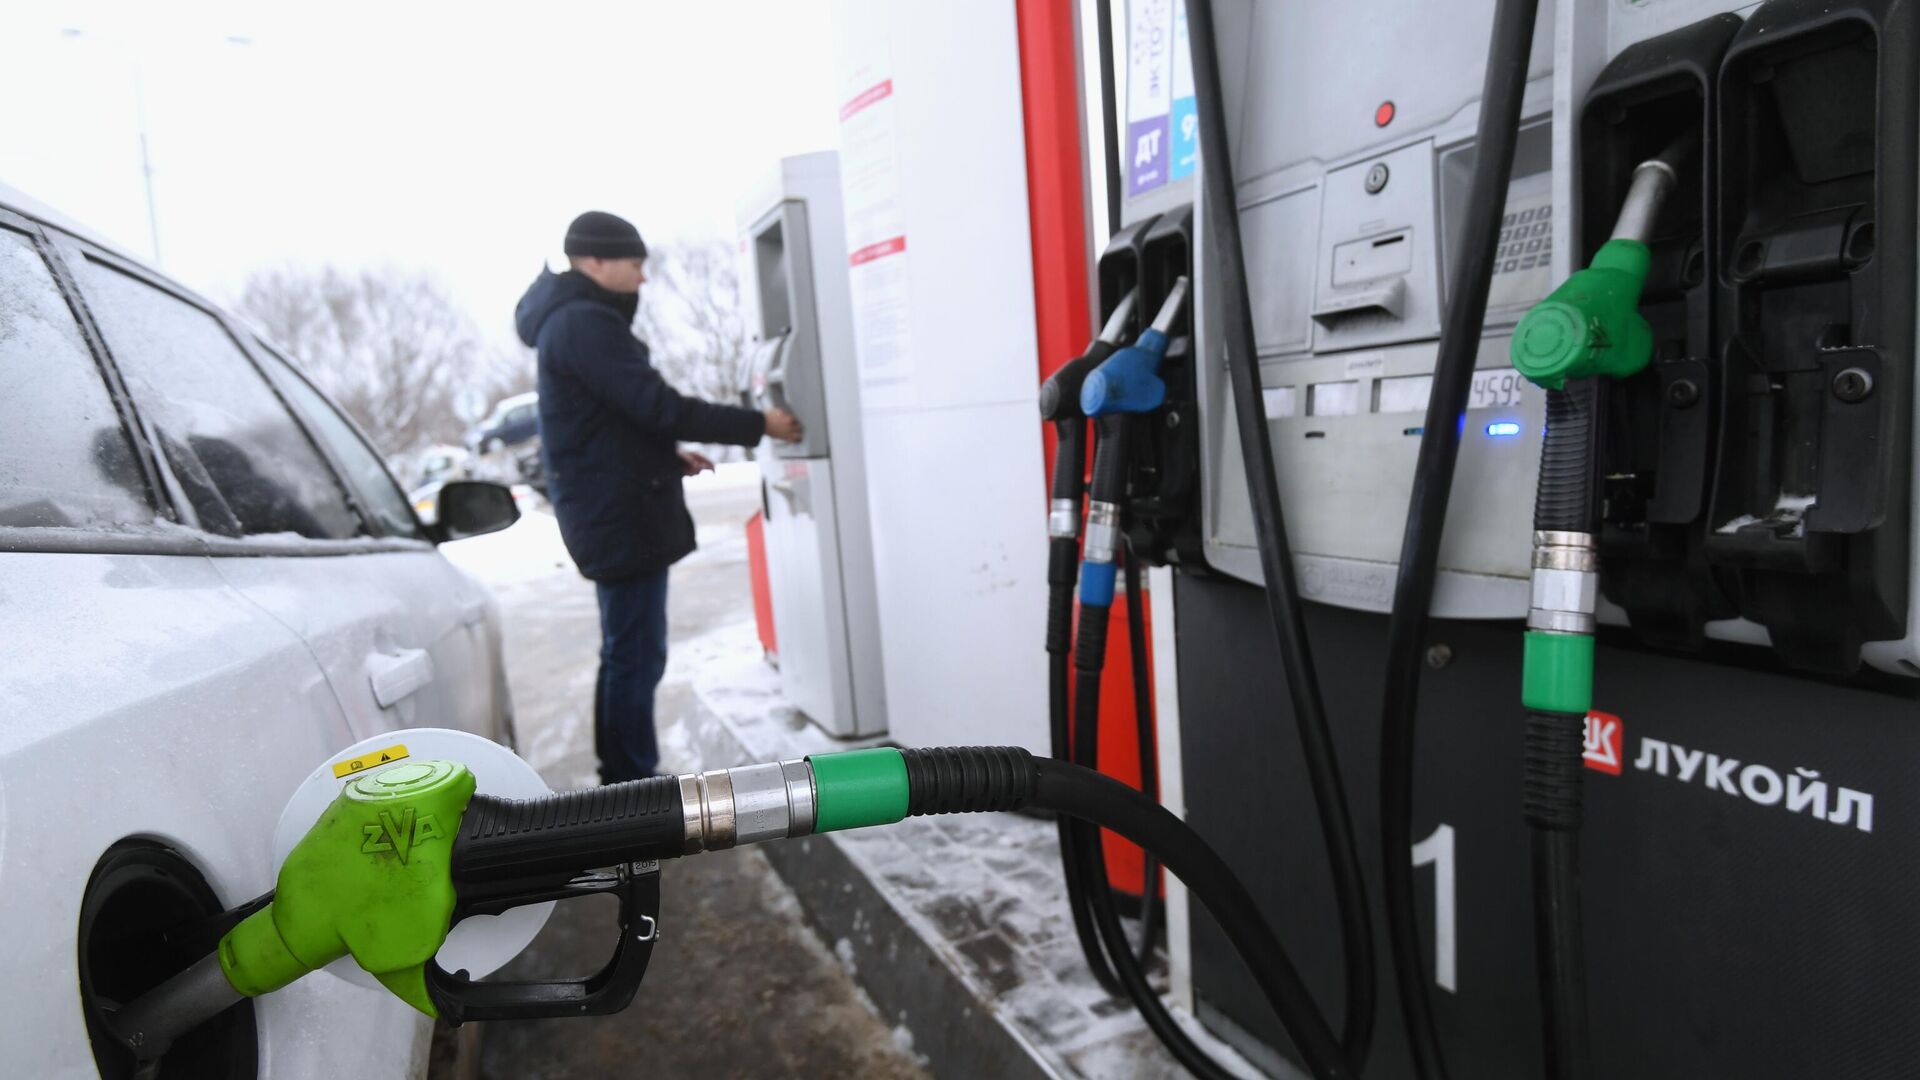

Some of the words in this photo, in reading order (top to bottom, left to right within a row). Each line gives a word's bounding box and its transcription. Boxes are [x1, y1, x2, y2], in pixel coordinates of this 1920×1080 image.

[1135, 128, 1162, 168] ДТ
[1181, 113, 1198, 142] 9
[1634, 737, 1874, 833] ЛУКОЙЛ
[1411, 823, 1457, 994] 1
